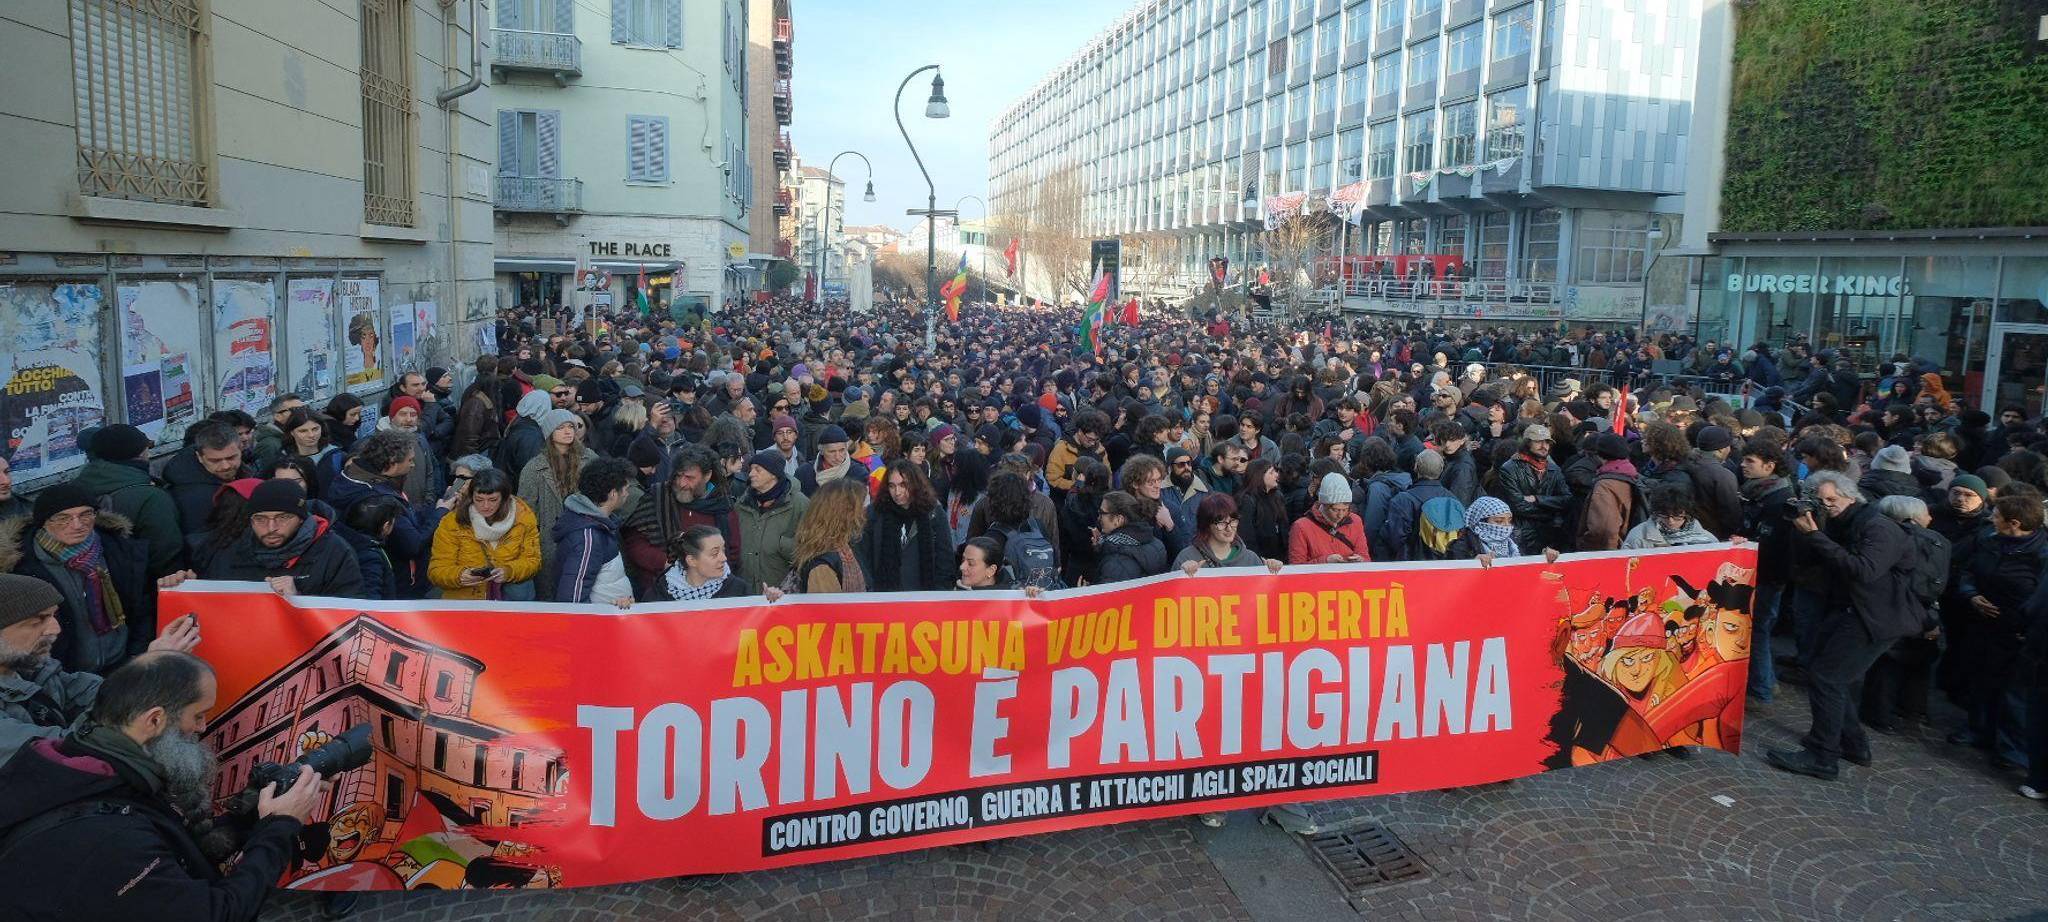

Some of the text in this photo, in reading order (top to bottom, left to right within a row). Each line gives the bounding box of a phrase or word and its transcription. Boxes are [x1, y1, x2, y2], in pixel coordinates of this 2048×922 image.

[589, 241, 671, 257] THE PLACE
[1728, 274, 1910, 296] BURGER KING
[732, 581, 1409, 687] ASKATASUNA VUOL DIRE LIBERTÀ
[577, 636, 1512, 827] TORINO È PARTIGIANA
[770, 755, 1373, 851] CONTRO GOVERNO, GUERRA E ATTACCHI AGLI SPAZI SOCIALI
